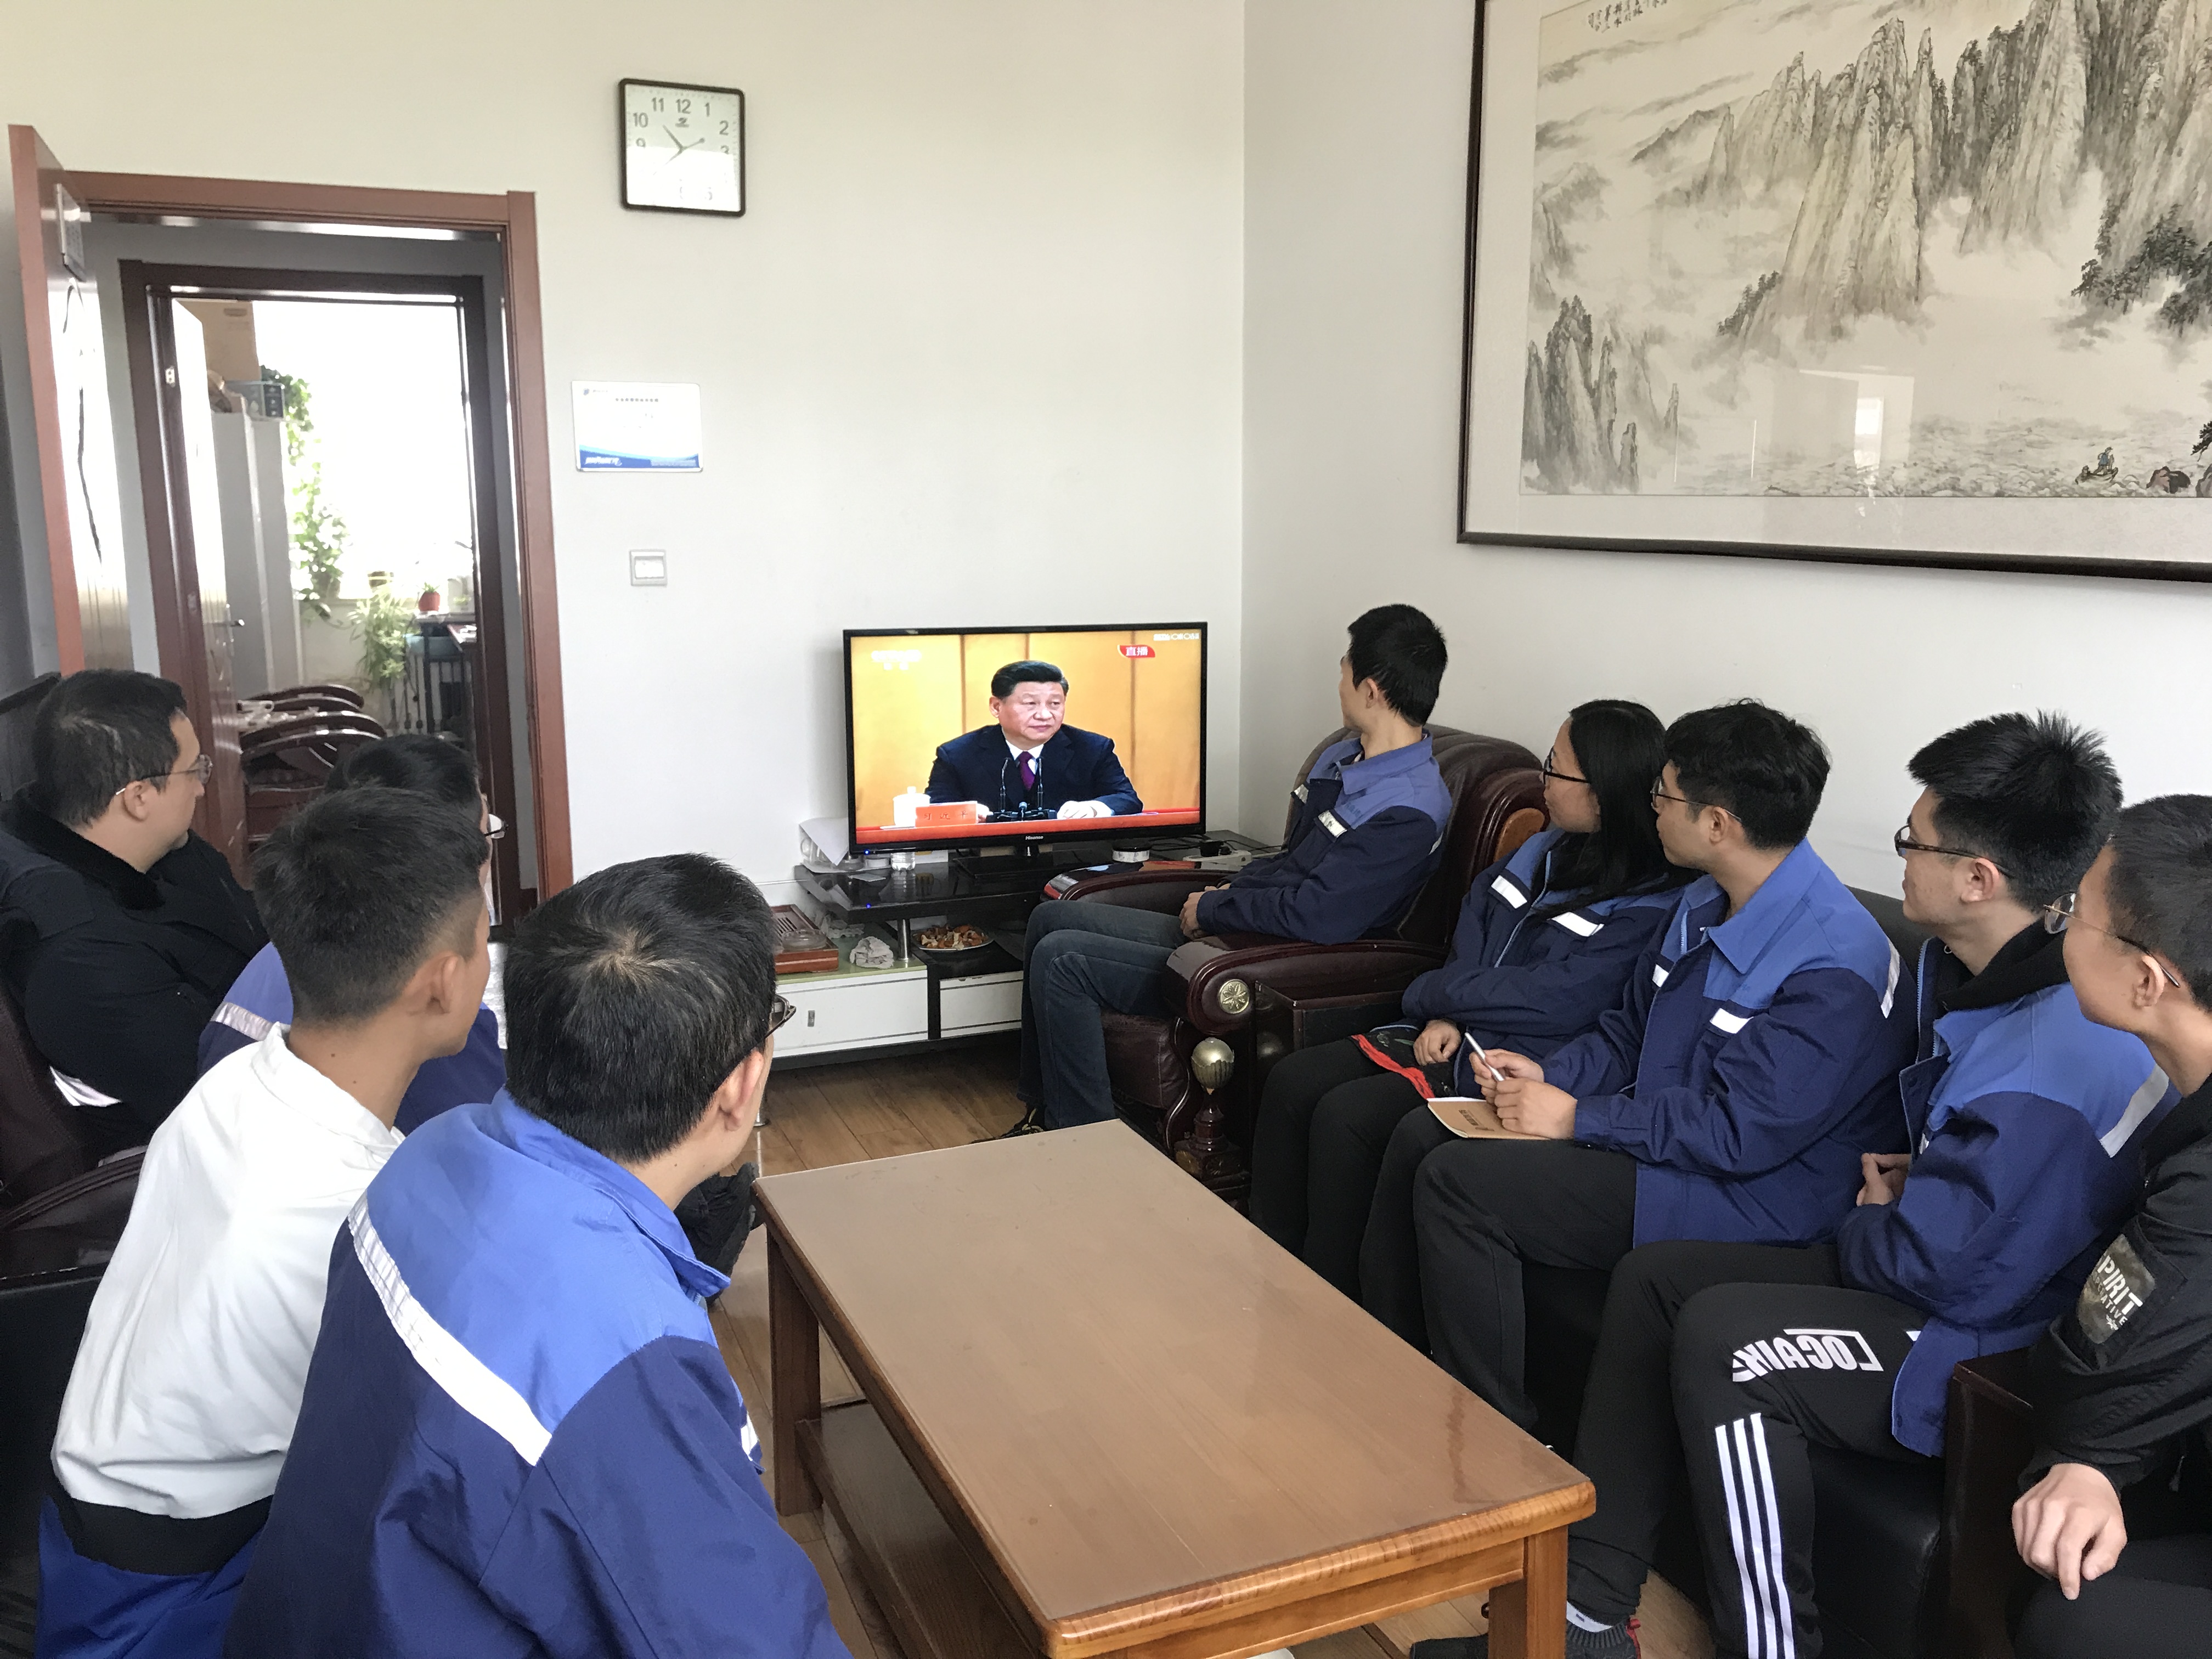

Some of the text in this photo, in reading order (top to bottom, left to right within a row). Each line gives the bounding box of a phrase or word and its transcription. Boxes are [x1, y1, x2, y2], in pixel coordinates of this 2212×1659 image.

[651, 97, 664, 112] 11
[675, 98, 691, 114] 12
[704, 102, 710, 117] 1
[633, 112, 648, 128] 10
[719, 120, 729, 136] 2
[1126, 646, 1149, 657] 直播
[924, 810, 968, 821] 习近平
[2093, 1252, 2143, 1316] PIRIT
